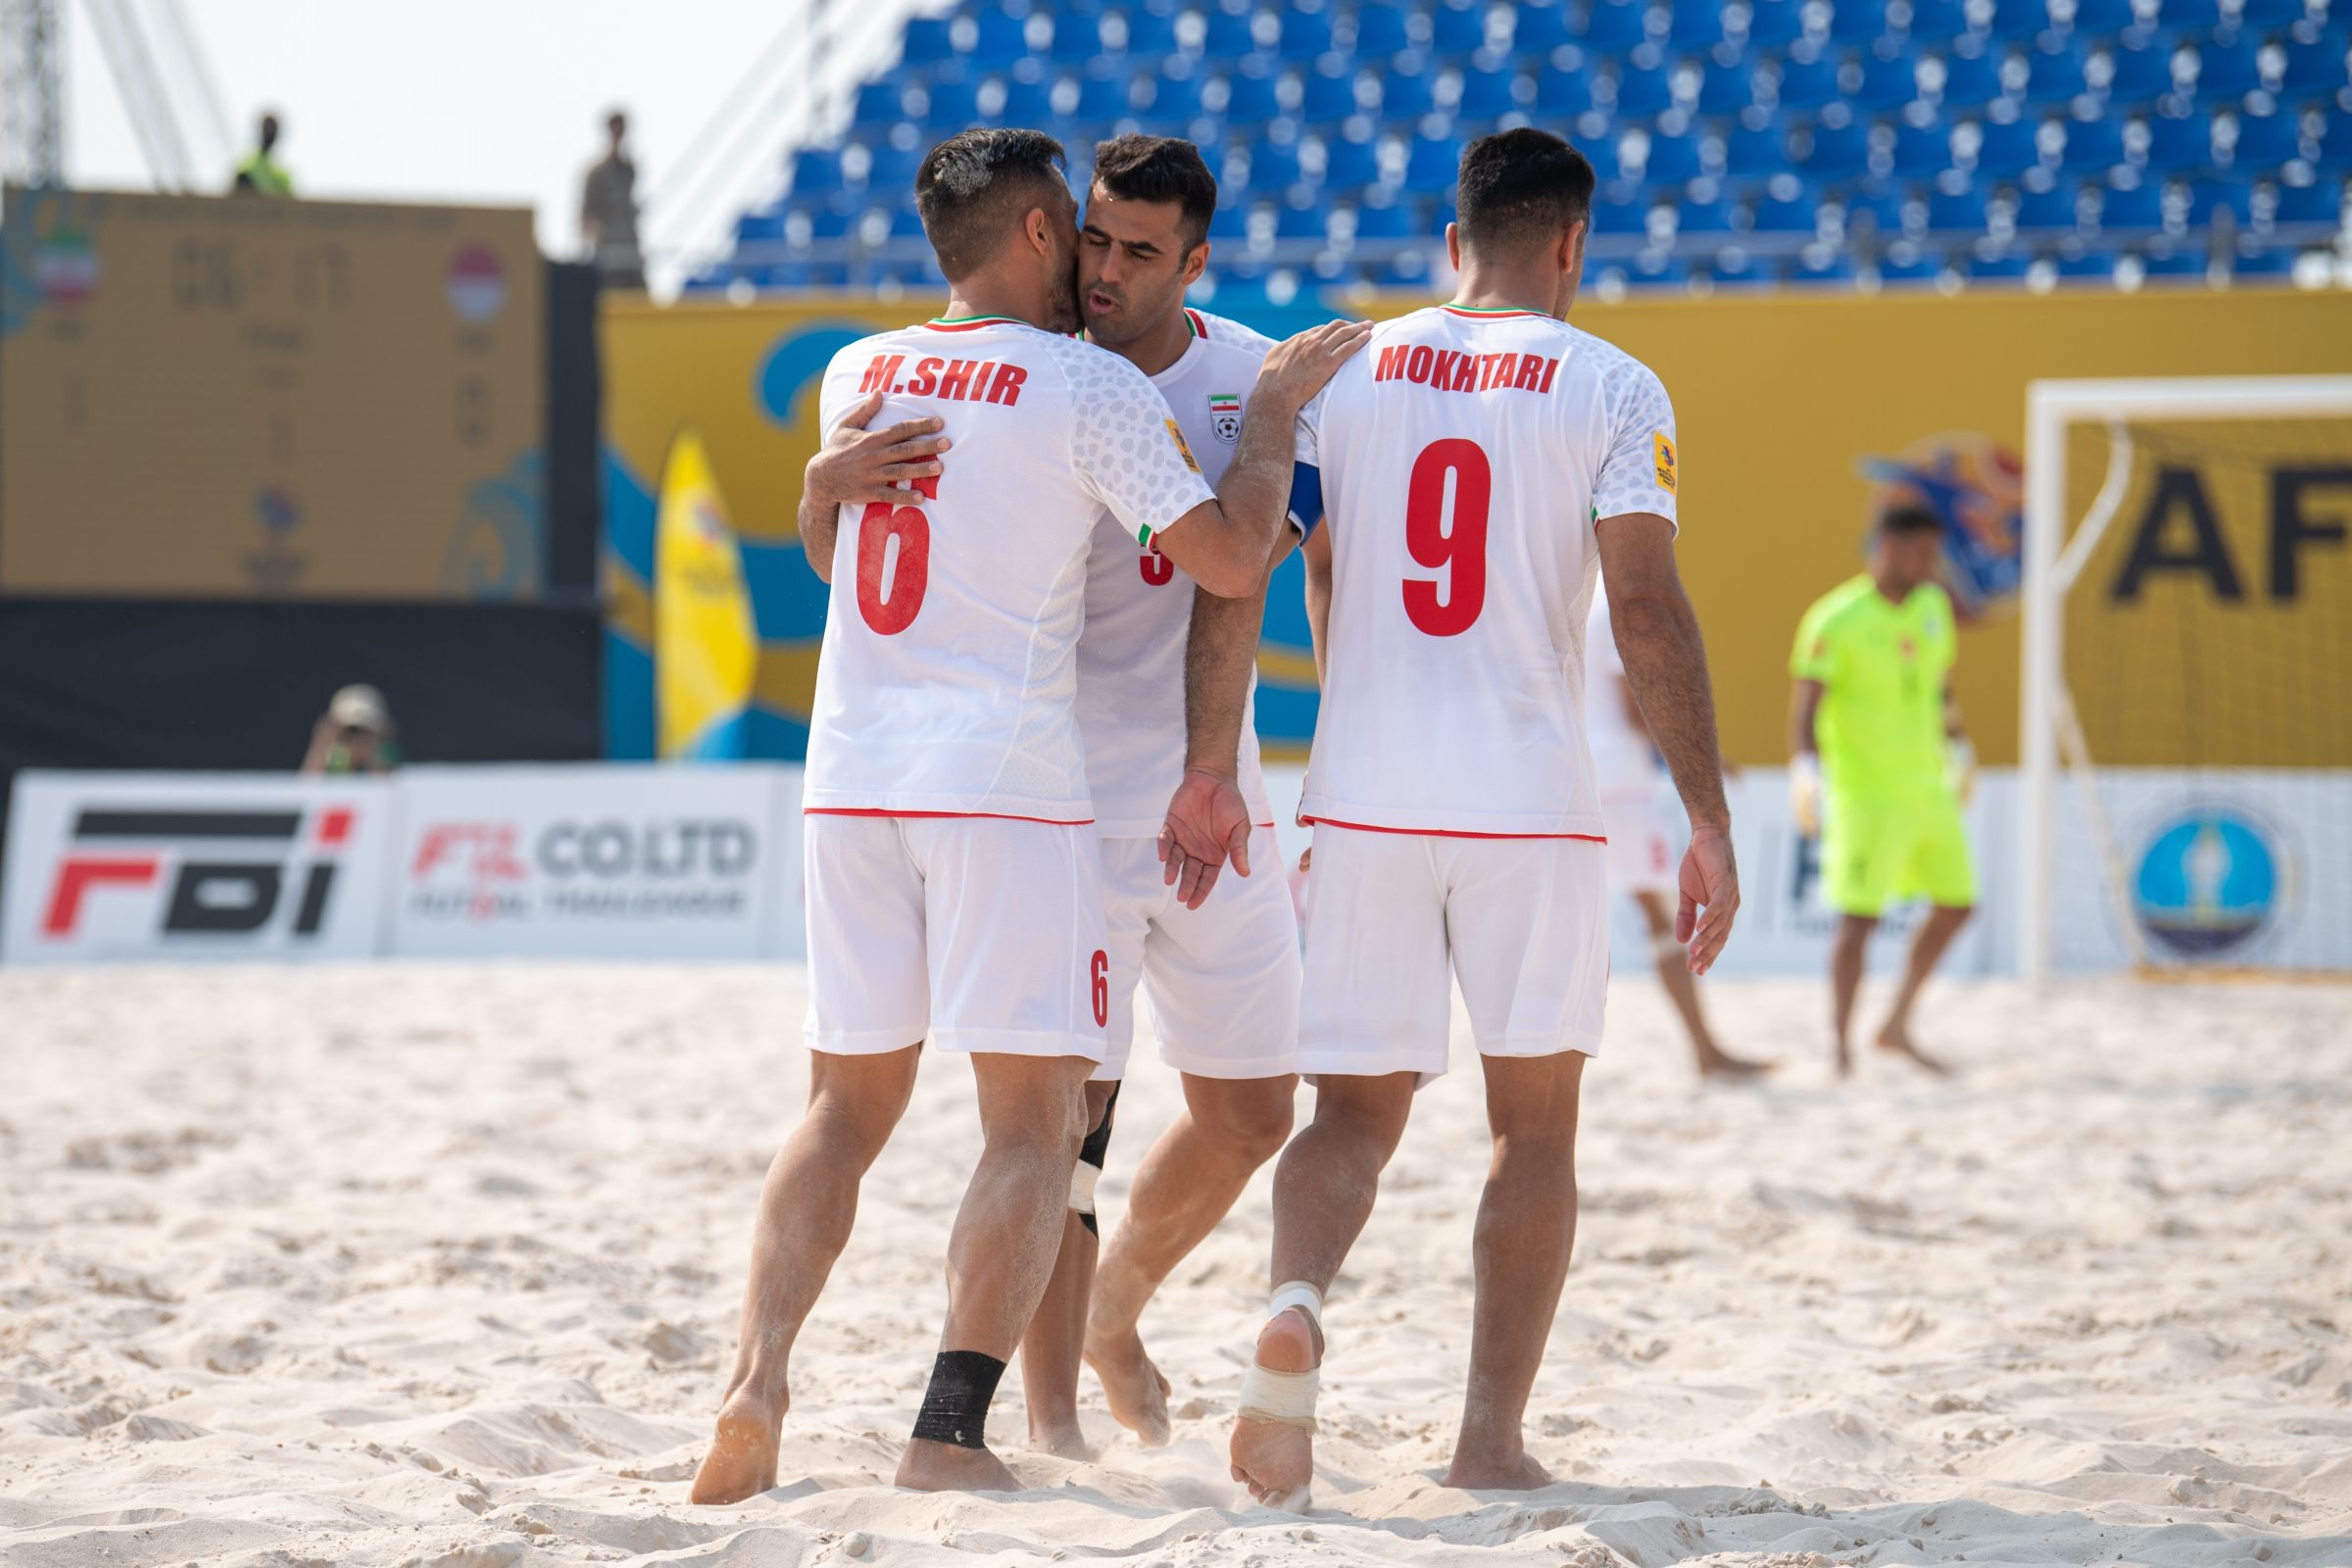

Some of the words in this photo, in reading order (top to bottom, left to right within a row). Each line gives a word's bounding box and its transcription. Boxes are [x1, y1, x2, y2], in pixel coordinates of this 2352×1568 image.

[858, 354, 1028, 407] M.SHIR
[1375, 344, 1558, 394] MOKHTARI
[857, 454, 940, 636] 6
[1402, 438, 1492, 637] 9
[1091, 950, 1108, 1027] 6
